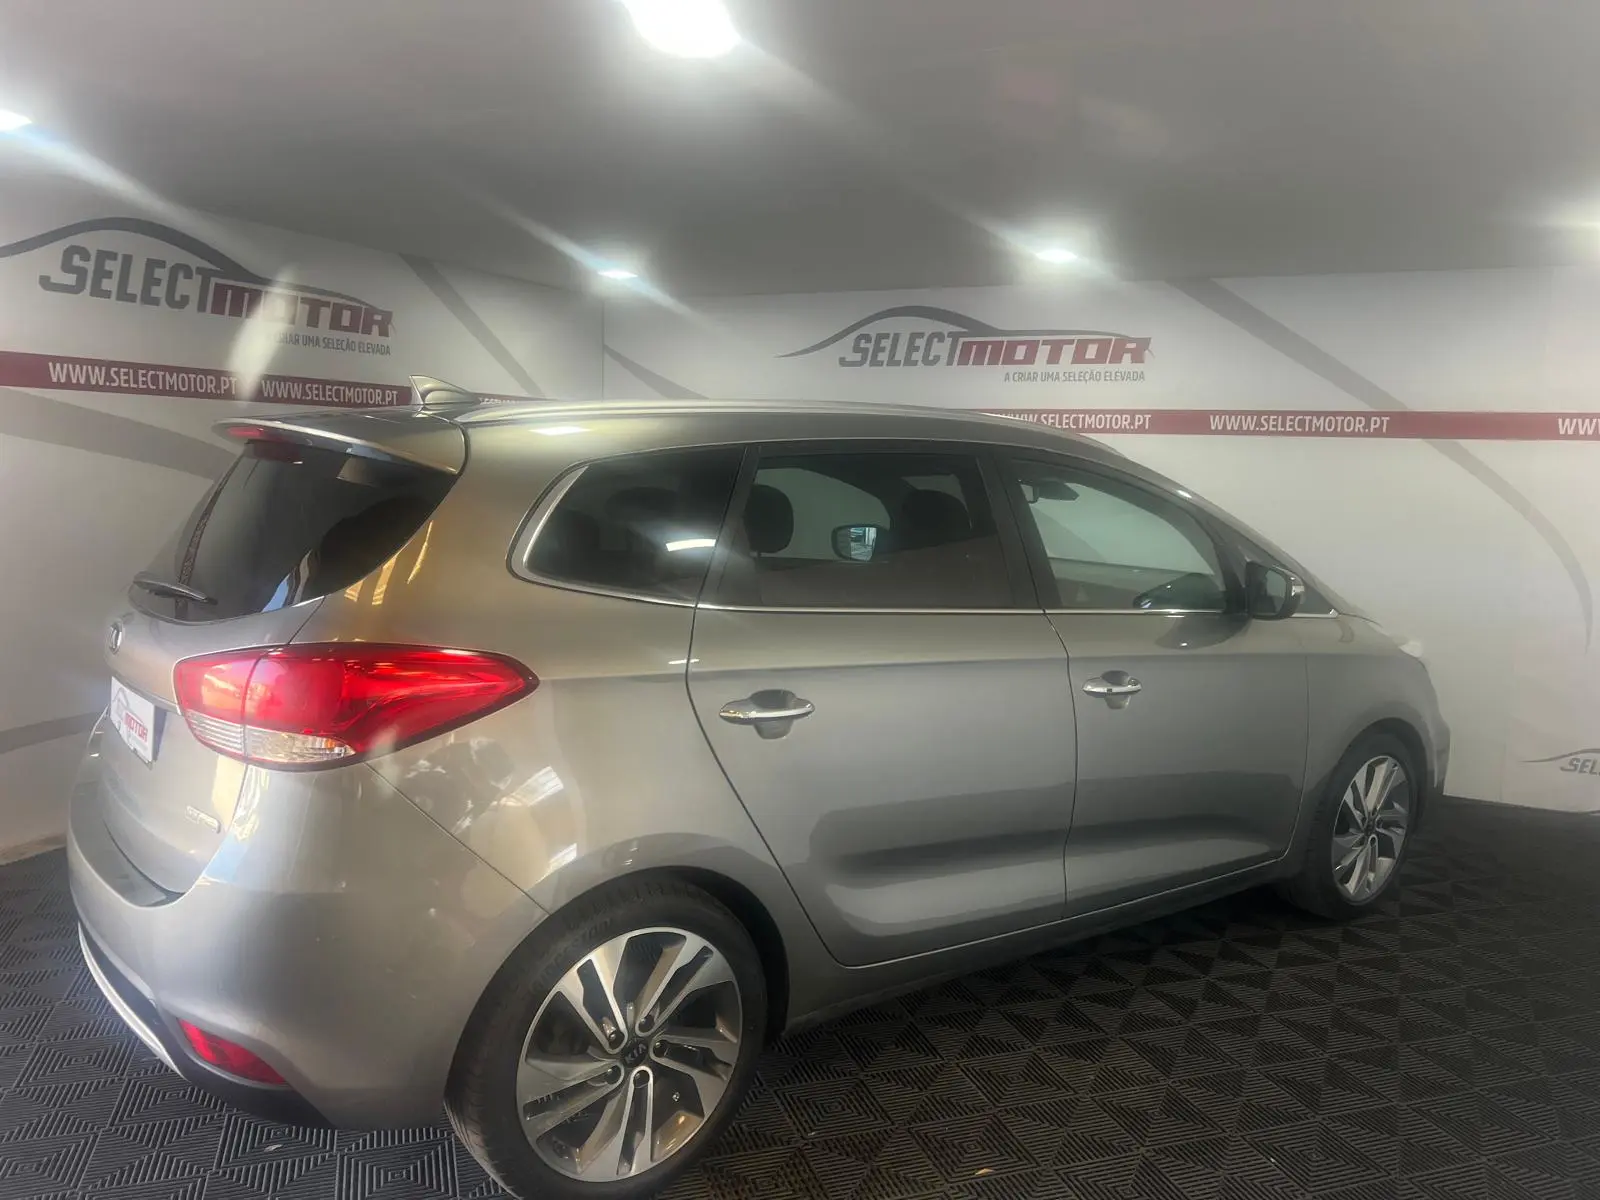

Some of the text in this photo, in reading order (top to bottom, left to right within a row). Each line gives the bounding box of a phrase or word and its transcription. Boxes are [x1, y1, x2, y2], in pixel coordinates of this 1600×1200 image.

[275, 331, 300, 346] RIAR
[302, 335, 321, 348] UMA
[358, 341, 391, 356] ELEVADA
[48, 361, 237, 395] WWW.SELECTMOTOR.PT
[1004, 369, 1145, 384] A CRIAR UMA SELEÇÃO ELEVADA
[261, 379, 398, 405] WWW.SELECTMOTOR.PT
[1002, 413, 1152, 430] WSELECTMOTOR.PT
[1209, 415, 1390, 433] WWW.SELECTMOTOR.PT
[1558, 418, 1600, 435] WW
[1559, 757, 1600, 776] SEL
